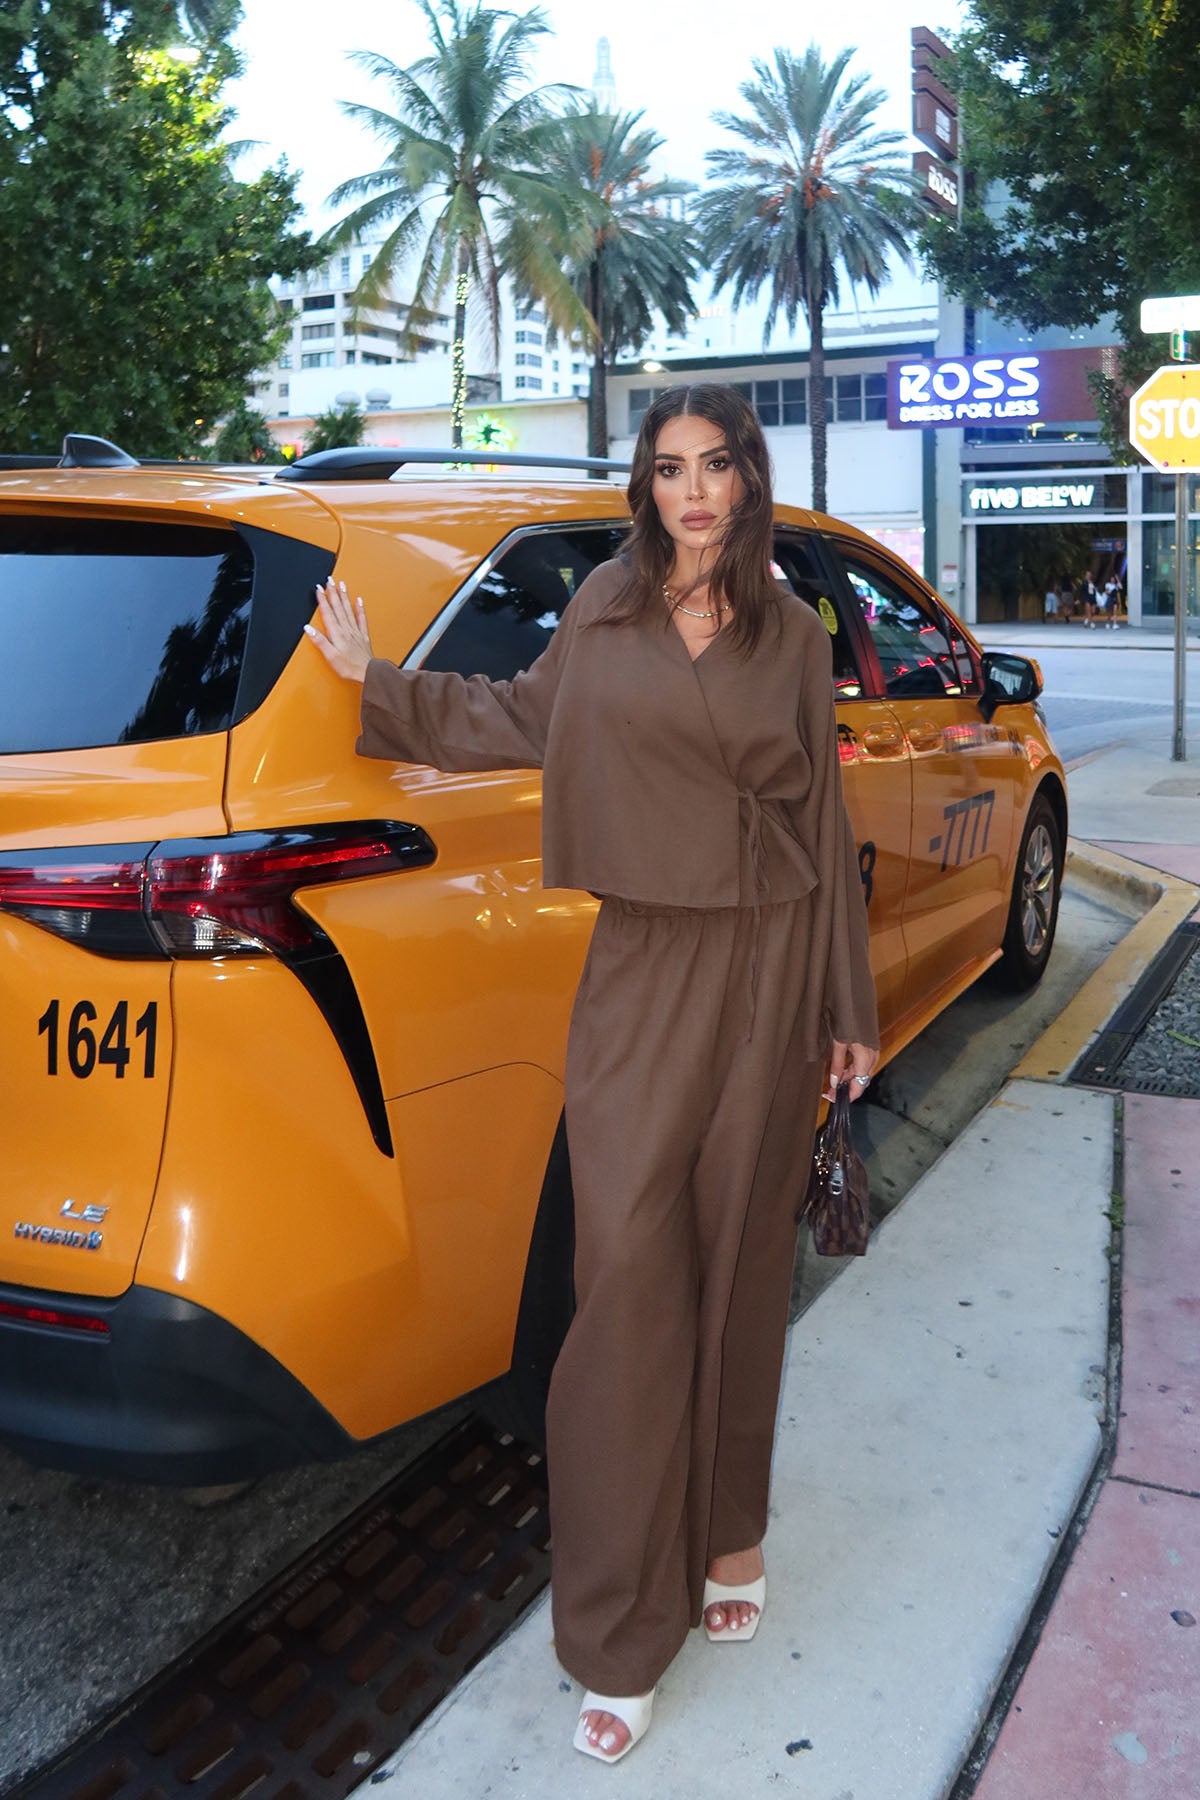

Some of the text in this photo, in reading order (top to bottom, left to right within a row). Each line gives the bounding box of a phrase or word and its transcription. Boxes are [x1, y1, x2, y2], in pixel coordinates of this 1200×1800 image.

[899, 357, 1040, 403] ROSS
[899, 399, 1040, 422] DRESS FOR LESS
[1138, 397, 1200, 440] STO
[969, 487, 1019, 509] five
[38, 999, 158, 1079] 1641
[59, 1198, 110, 1223] LE
[14, 1221, 88, 1248] HYBRID
